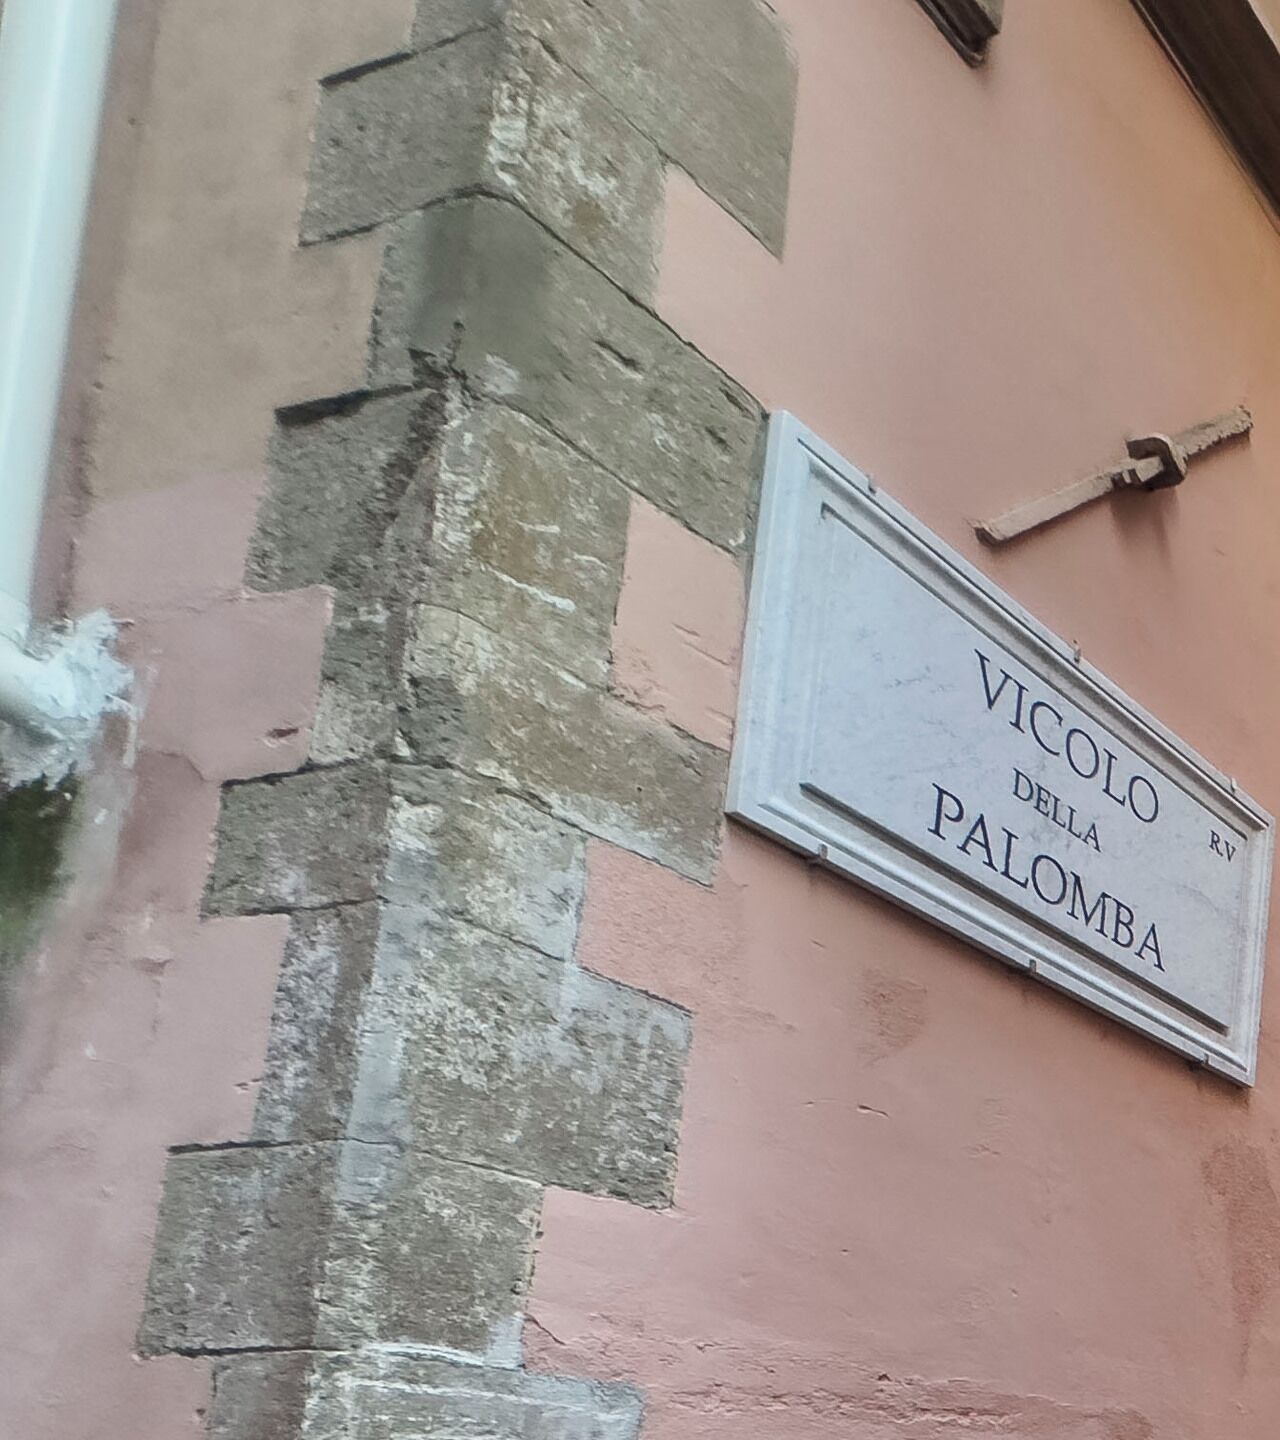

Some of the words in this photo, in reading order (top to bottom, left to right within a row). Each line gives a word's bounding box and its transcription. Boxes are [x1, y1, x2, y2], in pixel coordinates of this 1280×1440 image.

[974, 648, 1160, 824] VICOLO
[1012, 768, 1102, 852] DELLA
[928, 783, 1167, 973] PALOMBA
